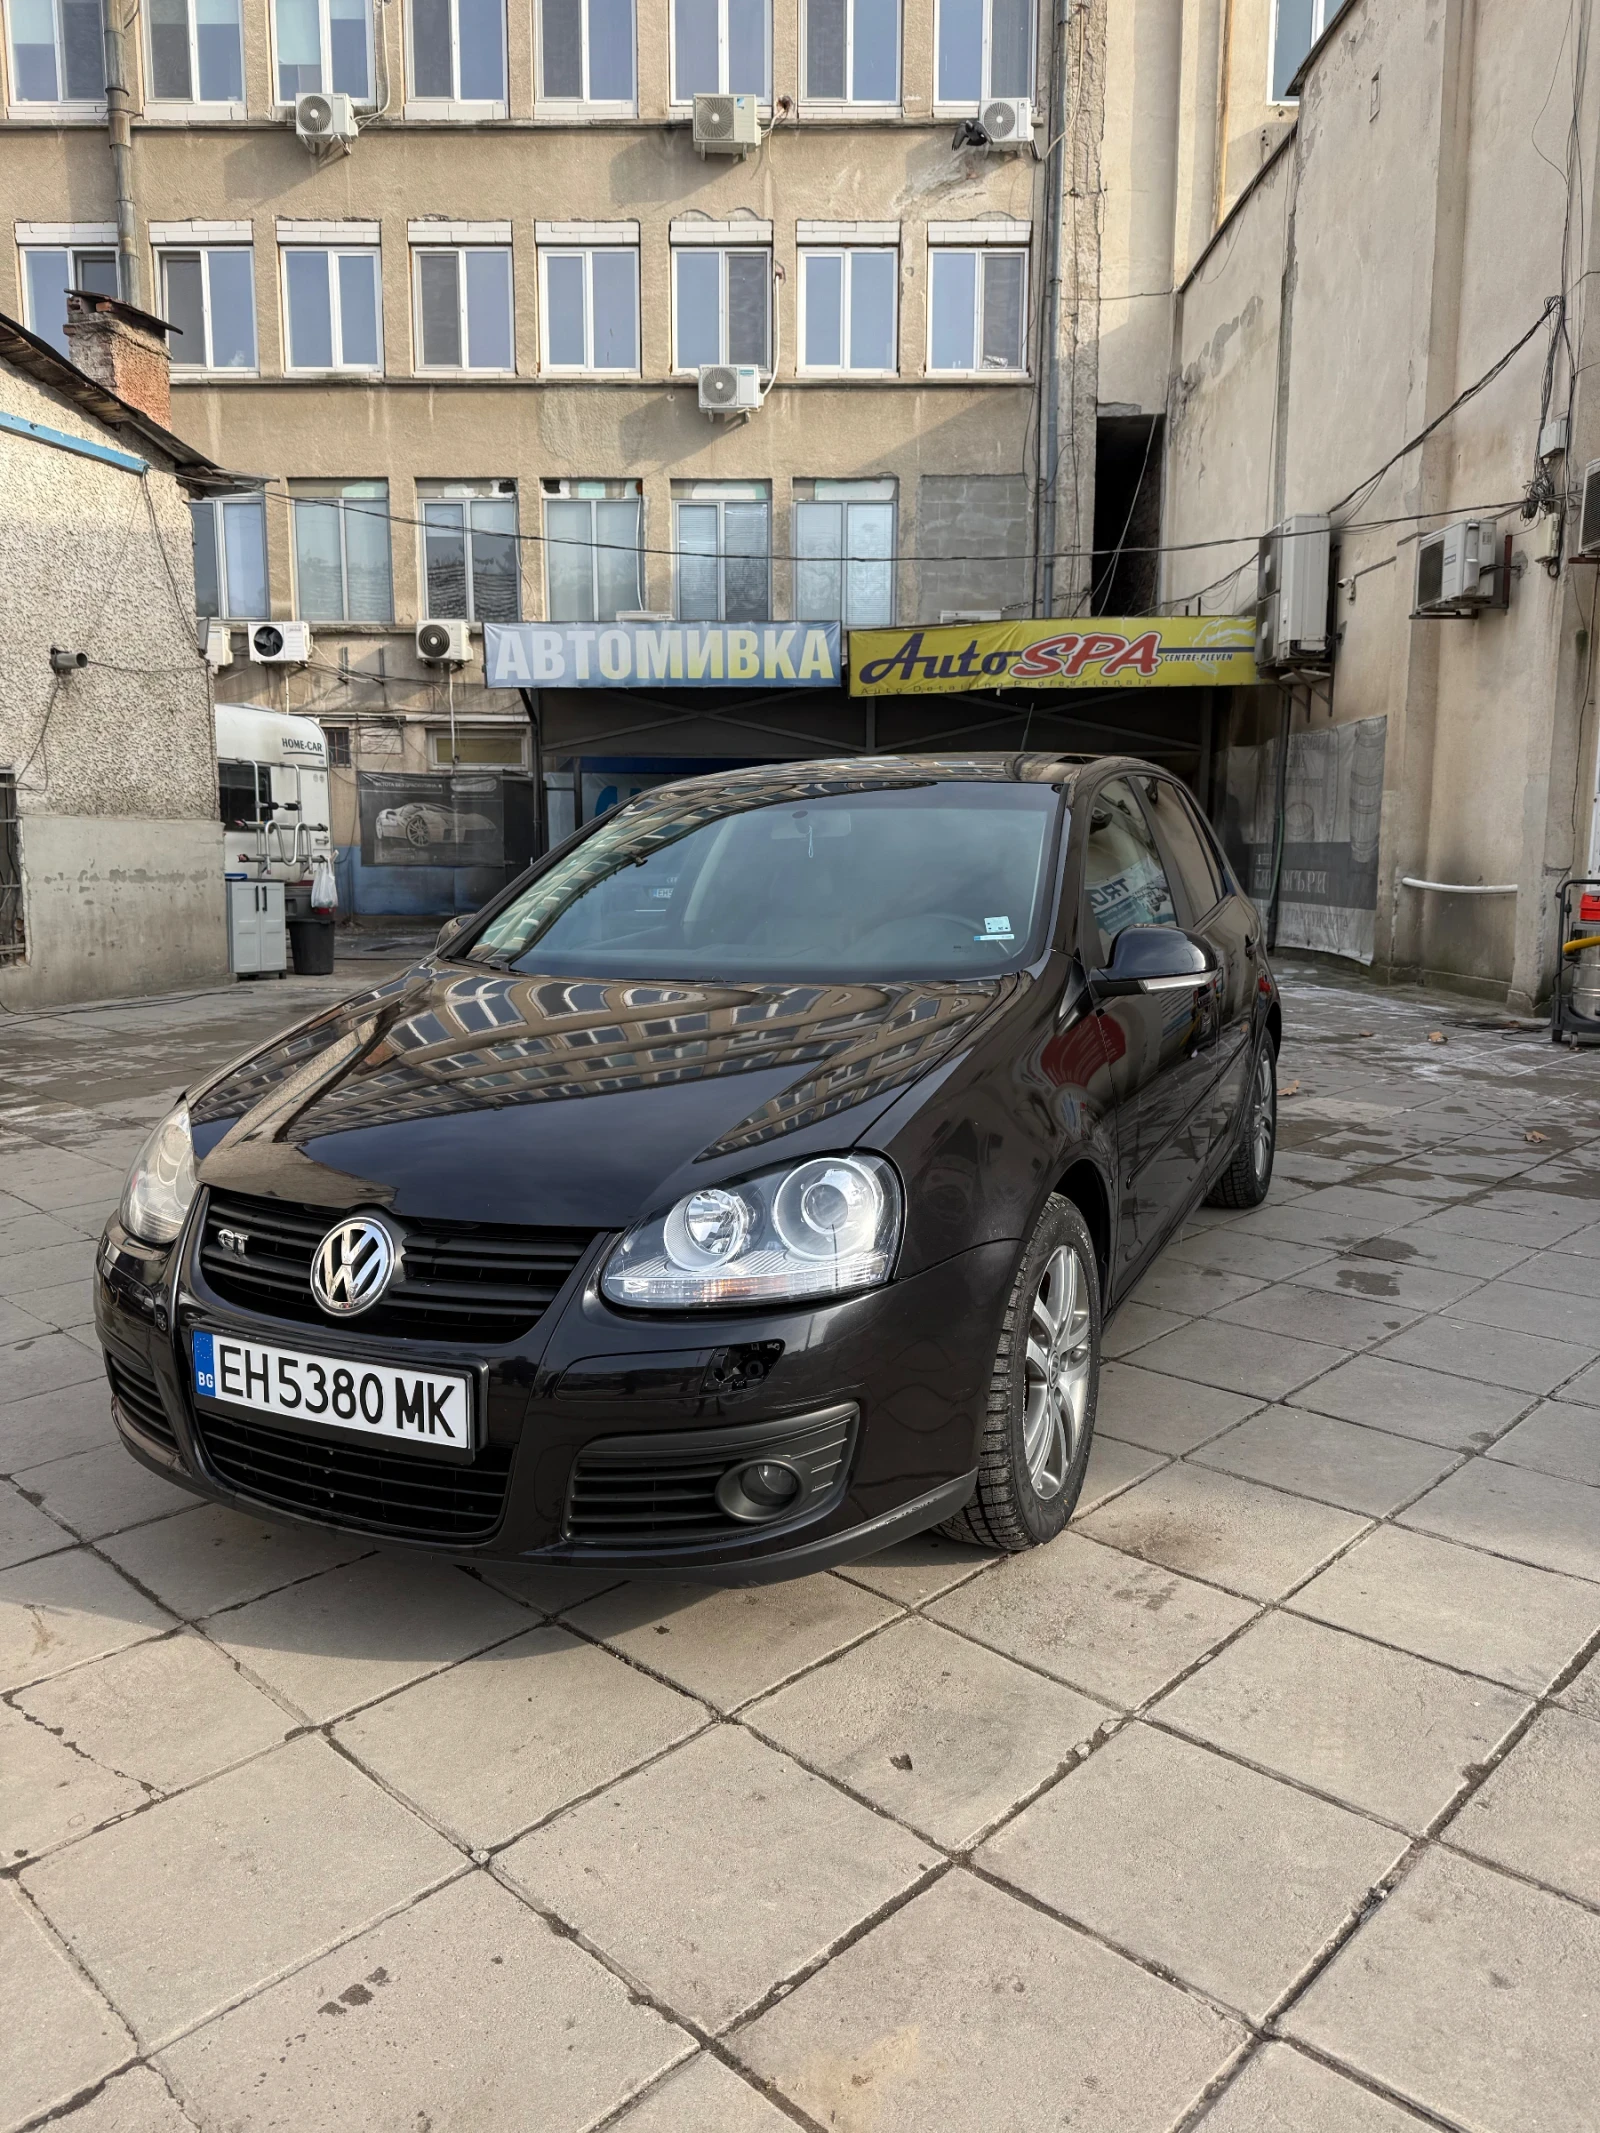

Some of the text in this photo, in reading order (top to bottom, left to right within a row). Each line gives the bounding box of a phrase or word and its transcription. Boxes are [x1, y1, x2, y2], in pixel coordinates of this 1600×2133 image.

[494, 629, 834, 680] АВТОМИВКА
[858, 632, 1162, 685] Auto SPA
[1165, 653, 1233, 662] CENTRE-PLEVEN
[861, 687, 903, 695] Auto
[1014, 677, 1152, 689] Professionals
[281, 737, 323, 752] HOME-CAR
[217, 1229, 249, 1254] GT
[198, 1371, 214, 1388] BG
[277, 1356, 384, 1425] 5380
[394, 1376, 456, 1438] MK
